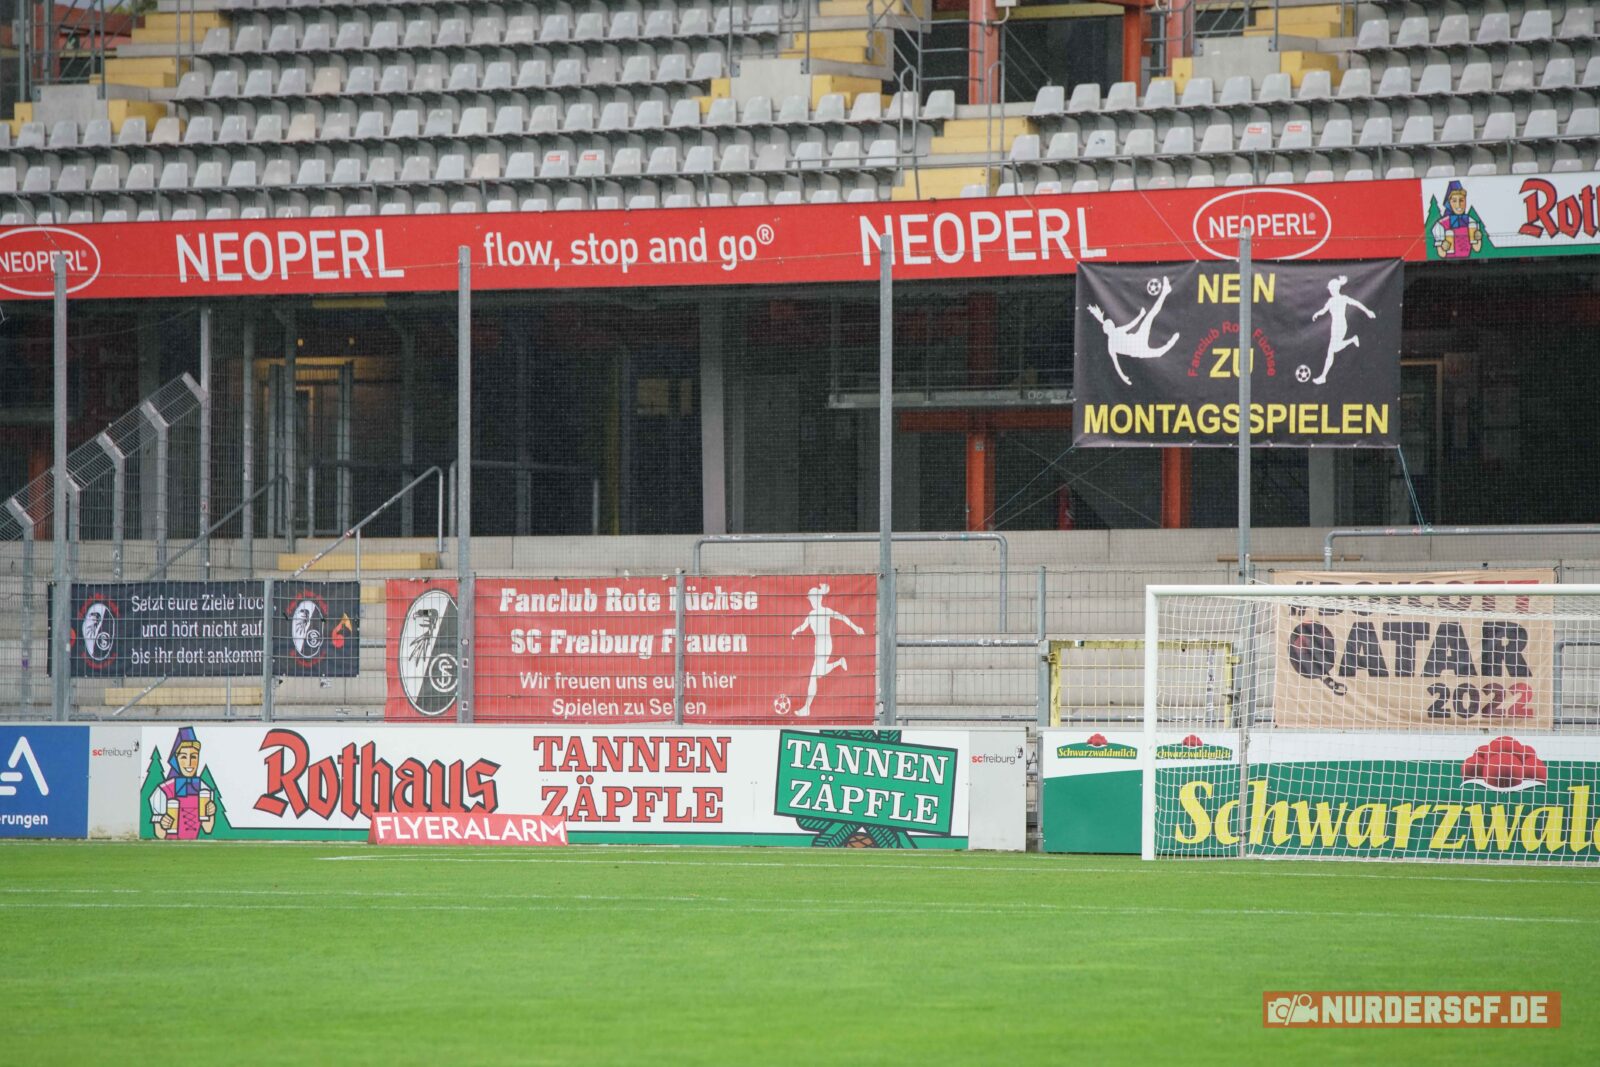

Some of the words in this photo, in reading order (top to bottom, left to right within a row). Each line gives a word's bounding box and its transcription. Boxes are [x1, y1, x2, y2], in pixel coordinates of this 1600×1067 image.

[1518, 178, 1600, 239] Rot
[483, 231, 560, 272] flow,
[570, 232, 638, 273] stop
[649, 227, 709, 263] and
[859, 207, 1107, 266] NEOPERL
[176, 228, 405, 283] NEOPERL
[1197, 272, 1276, 304] NEN
[1187, 328, 1220, 377] Fanclub
[1083, 402, 1389, 435] MONTAGSSPIELEN
[131, 594, 164, 613] Setzt
[167, 597, 198, 612] eure
[201, 594, 235, 611] Ziele
[238, 593, 277, 611] hoc,
[499, 587, 598, 613] Fanclub
[605, 587, 661, 612] Rote
[142, 621, 168, 638] und
[172, 620, 199, 637] hört
[202, 620, 238, 637] nicht
[511, 628, 542, 654] SC
[550, 629, 654, 659] Freiburg
[661, 628, 748, 653] Fauen
[131, 648, 151, 664] bis
[154, 647, 173, 664] ihr
[176, 647, 204, 664] dort
[207, 647, 276, 664] ankomm.
[1288, 619, 1533, 681] QATAR
[520, 671, 551, 689] Wir
[554, 671, 611, 689] freuen
[616, 675, 647, 689] uns
[652, 671, 697, 689] euh
[701, 671, 737, 689] hier
[551, 698, 619, 719] Spielen
[623, 702, 645, 716] zu
[649, 697, 707, 715] Seen
[1426, 681, 1534, 719] 2022
[532, 735, 732, 774] TANNEN
[785, 738, 949, 786] TANNEN
[1058, 747, 1136, 758] Schwarzwaldmilch
[1157, 748, 1231, 759] chwarzwaldmilch
[253, 728, 502, 820] Rothaus
[540, 774, 724, 824] ZÄPFLE
[788, 774, 940, 826] ZÄPFLE
[0, 813, 48, 829] rungen
[376, 815, 568, 843] FLYERALARM
